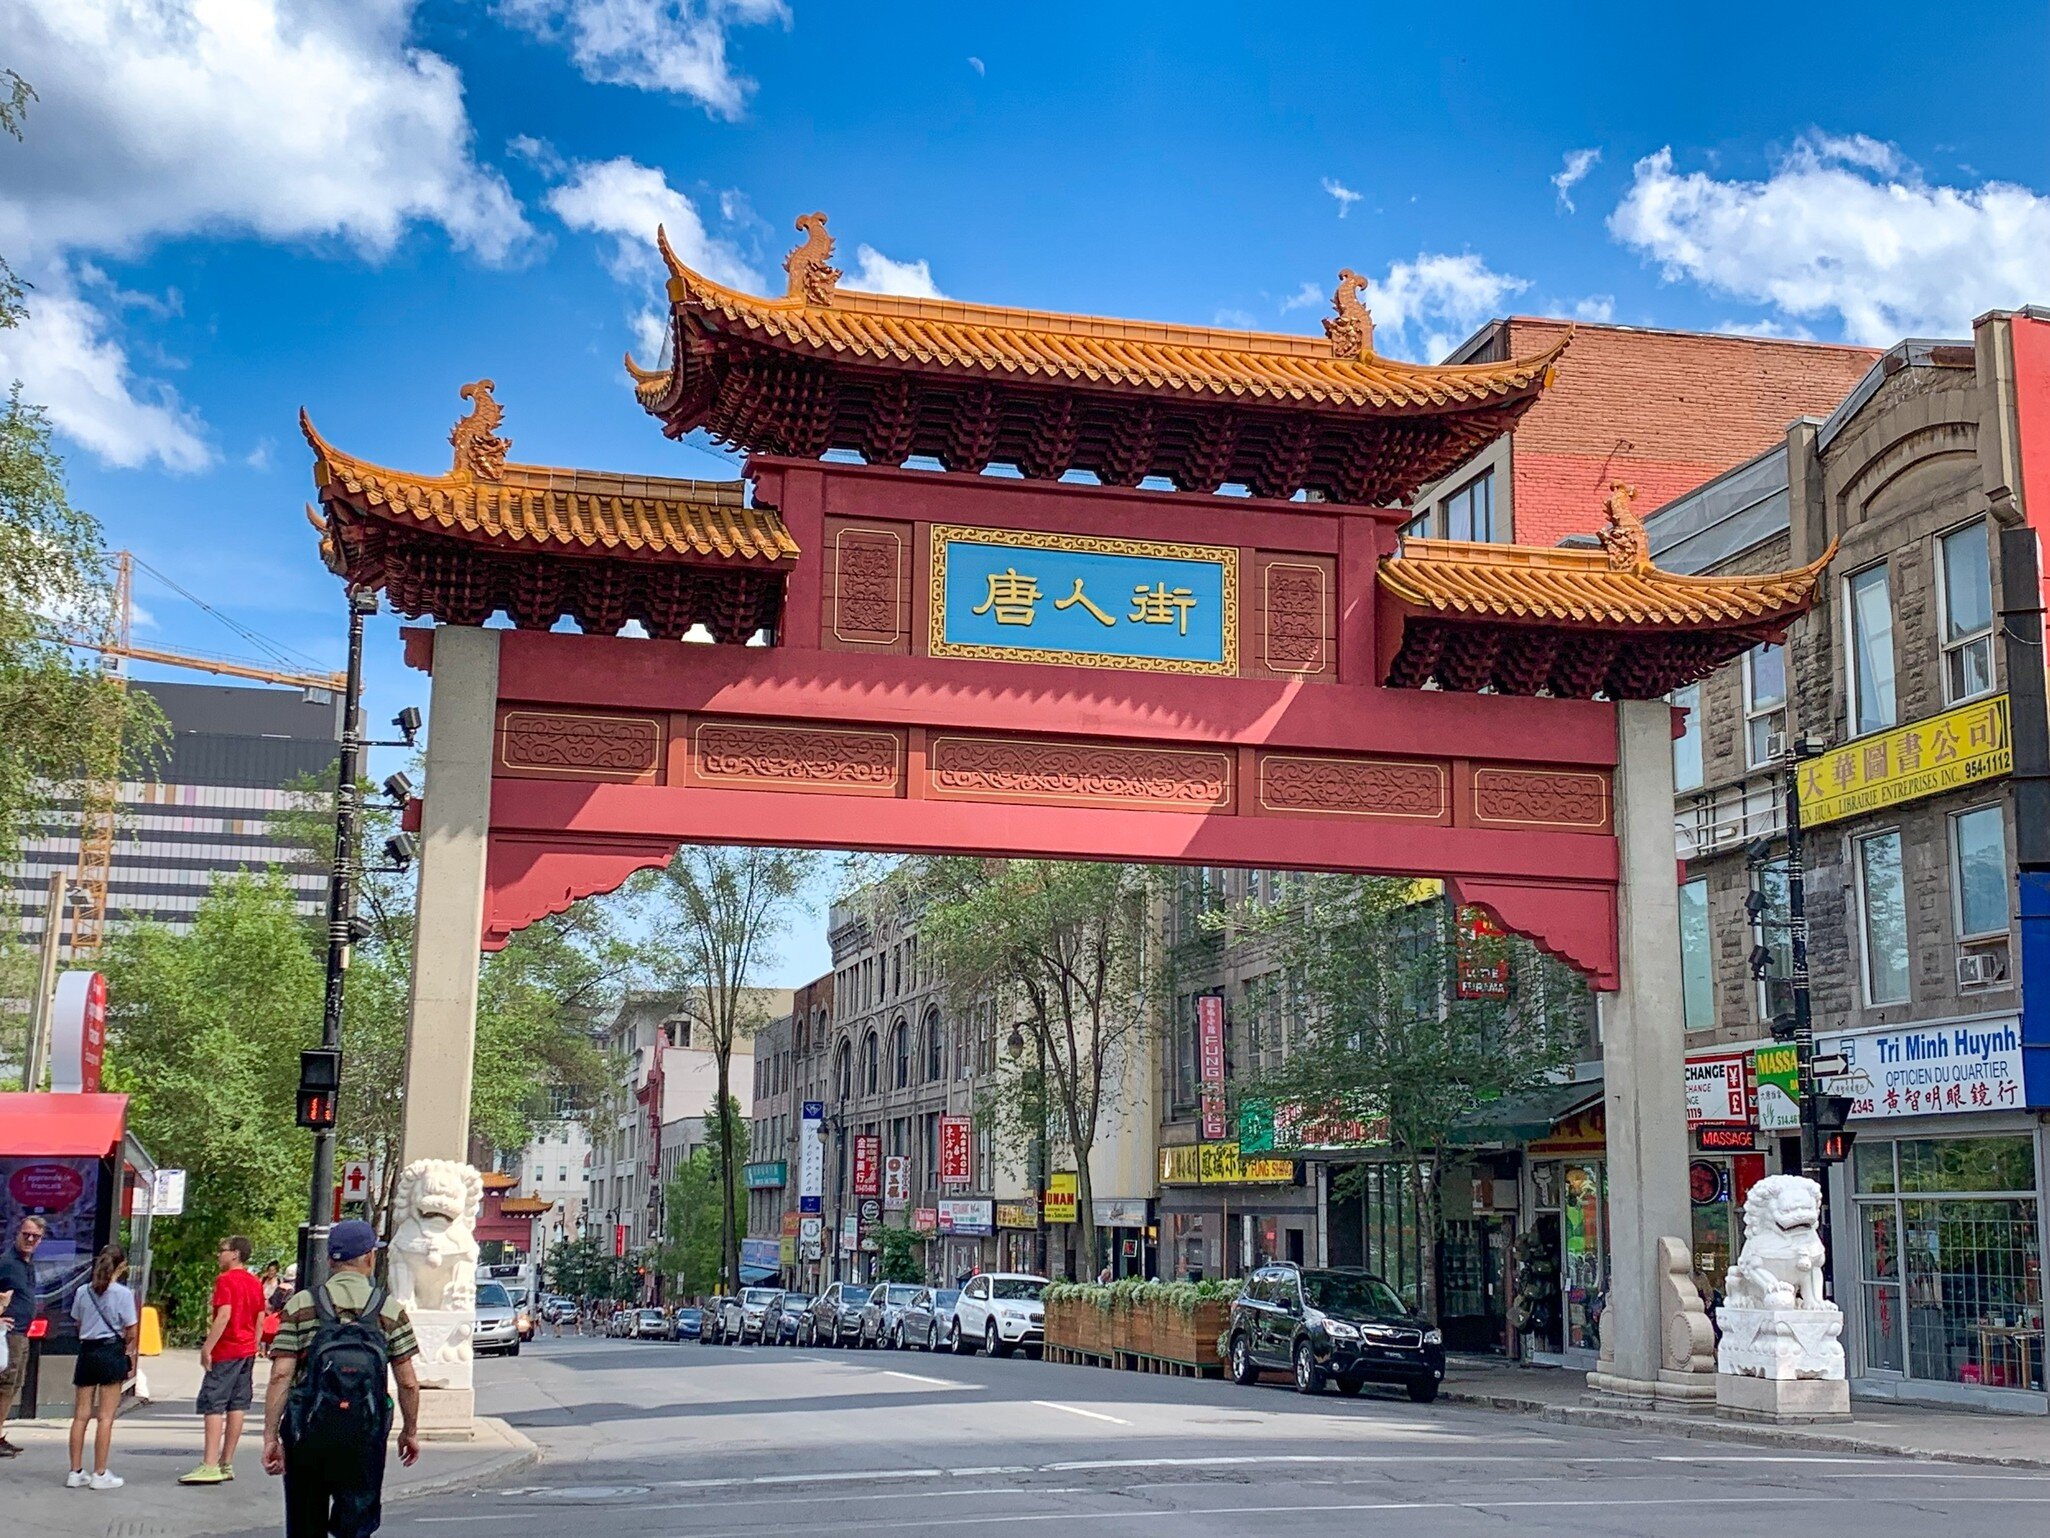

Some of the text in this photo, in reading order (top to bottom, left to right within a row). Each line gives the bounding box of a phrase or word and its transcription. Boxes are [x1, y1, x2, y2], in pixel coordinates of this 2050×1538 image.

[972, 567, 1197, 636] 唐人街
[1801, 706, 1997, 802] 天華圖書公司
[1815, 803, 1833, 821] HUA
[1838, 788, 1878, 815] LIBRAIRIE
[1881, 771, 1938, 801] ENTREPRISES
[1941, 766, 1961, 786] INC.
[1964, 751, 2011, 779] 954-1112
[1205, 1036, 1219, 1077] FUNG
[1877, 1024, 2017, 1064] Tri Minh Huynh
[1885, 1060, 2009, 1088] OPTICIEN DU QUARTIER
[1851, 1098, 1875, 1114] 2345
[959, 1125, 968, 1175] MASSAGE
[1702, 1131, 1754, 1147] MASSAGE
[1825, 1135, 1843, 1156] 11
[1250, 1160, 1270, 1177] FUNG
